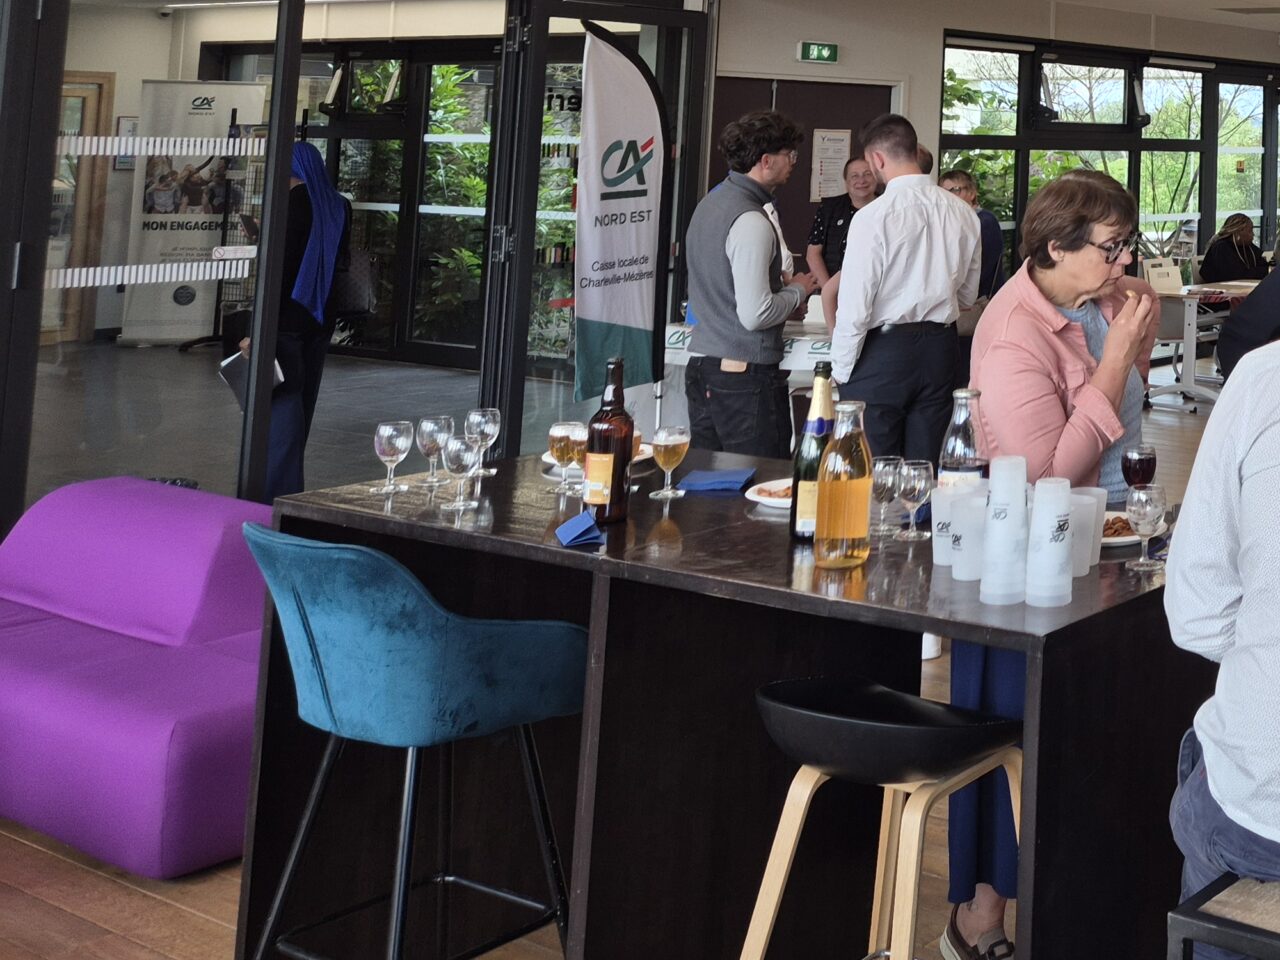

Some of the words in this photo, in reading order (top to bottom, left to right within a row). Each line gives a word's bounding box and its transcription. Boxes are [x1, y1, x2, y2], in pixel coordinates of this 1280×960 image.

[142, 221, 168, 231] MON
[170, 220, 242, 231] ENGAGEMEN
[594, 212, 627, 228] NORD
[630, 209, 653, 224] EST
[618, 256, 639, 268] locale
[639, 254, 649, 265] de
